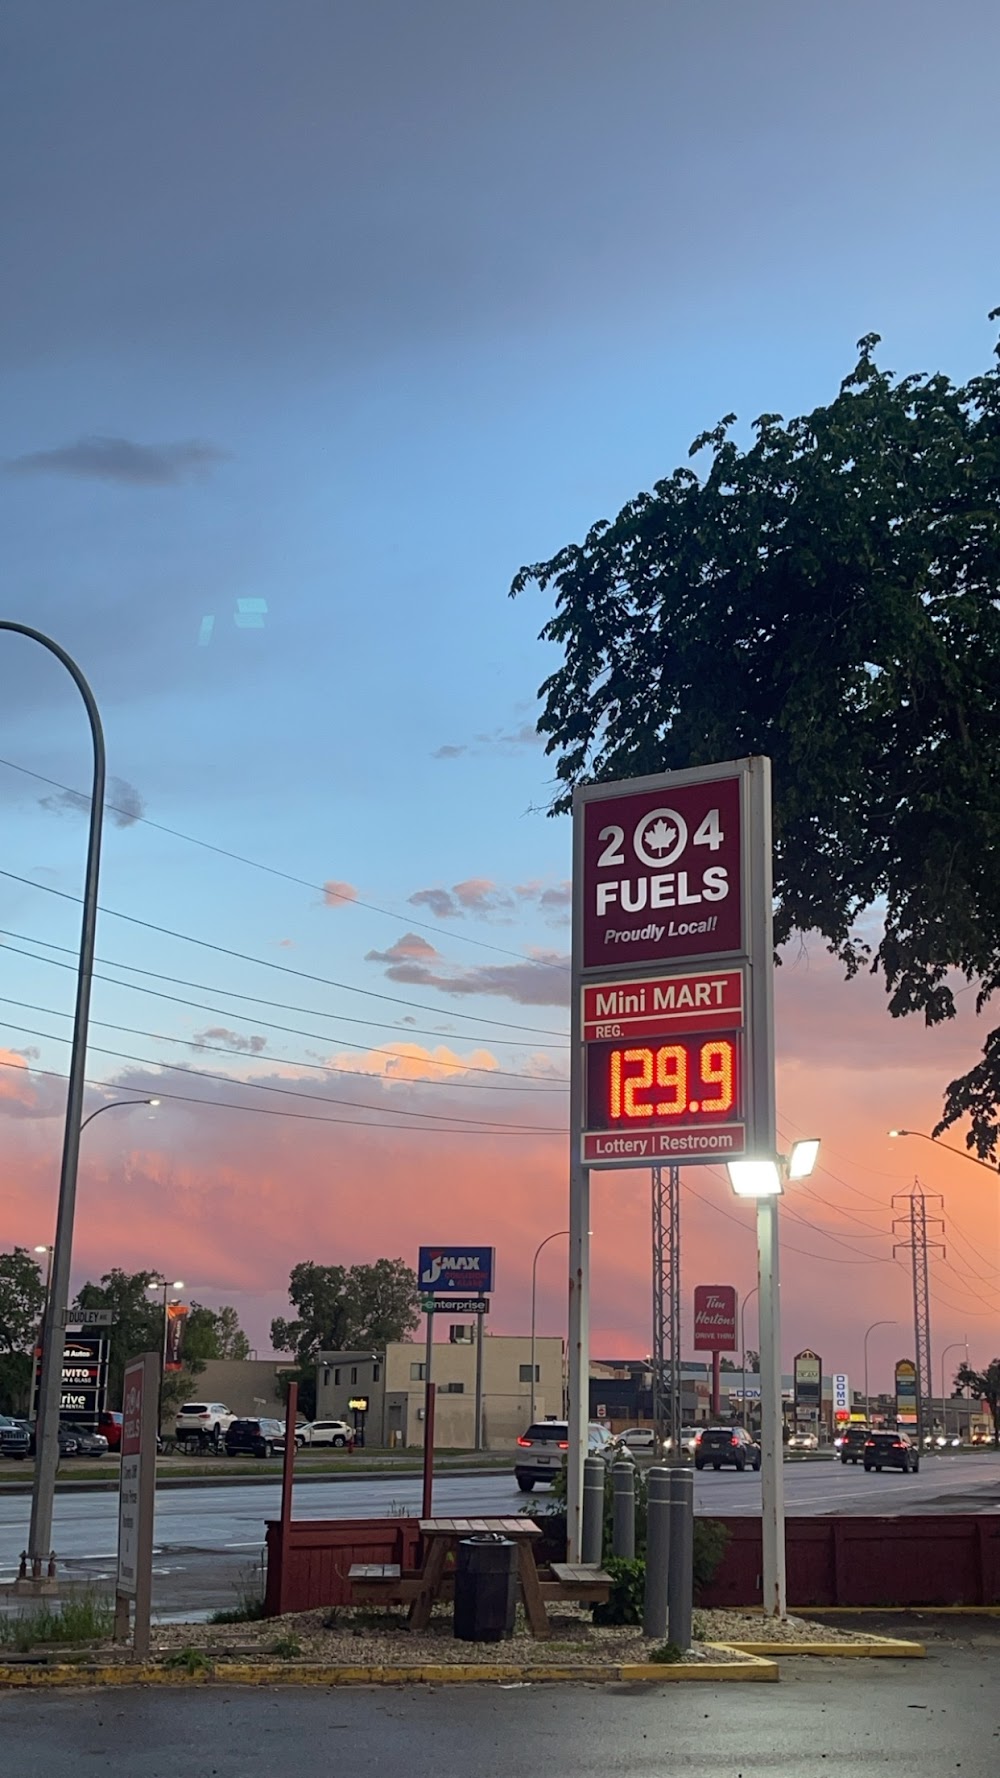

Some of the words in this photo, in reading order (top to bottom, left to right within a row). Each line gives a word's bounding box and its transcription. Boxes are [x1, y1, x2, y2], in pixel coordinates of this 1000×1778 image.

[597, 808, 724, 868] 204
[596, 866, 729, 916] FUELS
[604, 924, 665, 944] Proudly
[668, 916, 718, 937] Local!
[595, 988, 646, 1016] Mini
[653, 981, 728, 1010] MART
[595, 1024, 625, 1039] REG.
[610, 1041, 733, 1118] 129.9
[596, 1139, 647, 1155] Lottery
[660, 1134, 733, 1151] Restroom
[424, 1300, 485, 1311] enterprise
[706, 1295, 726, 1310] Tim
[69, 1311, 99, 1323] DUDLEY
[695, 1311, 735, 1326] Hortons
[60, 1393, 86, 1404] rive
[836, 1375, 846, 1406] DOMO
